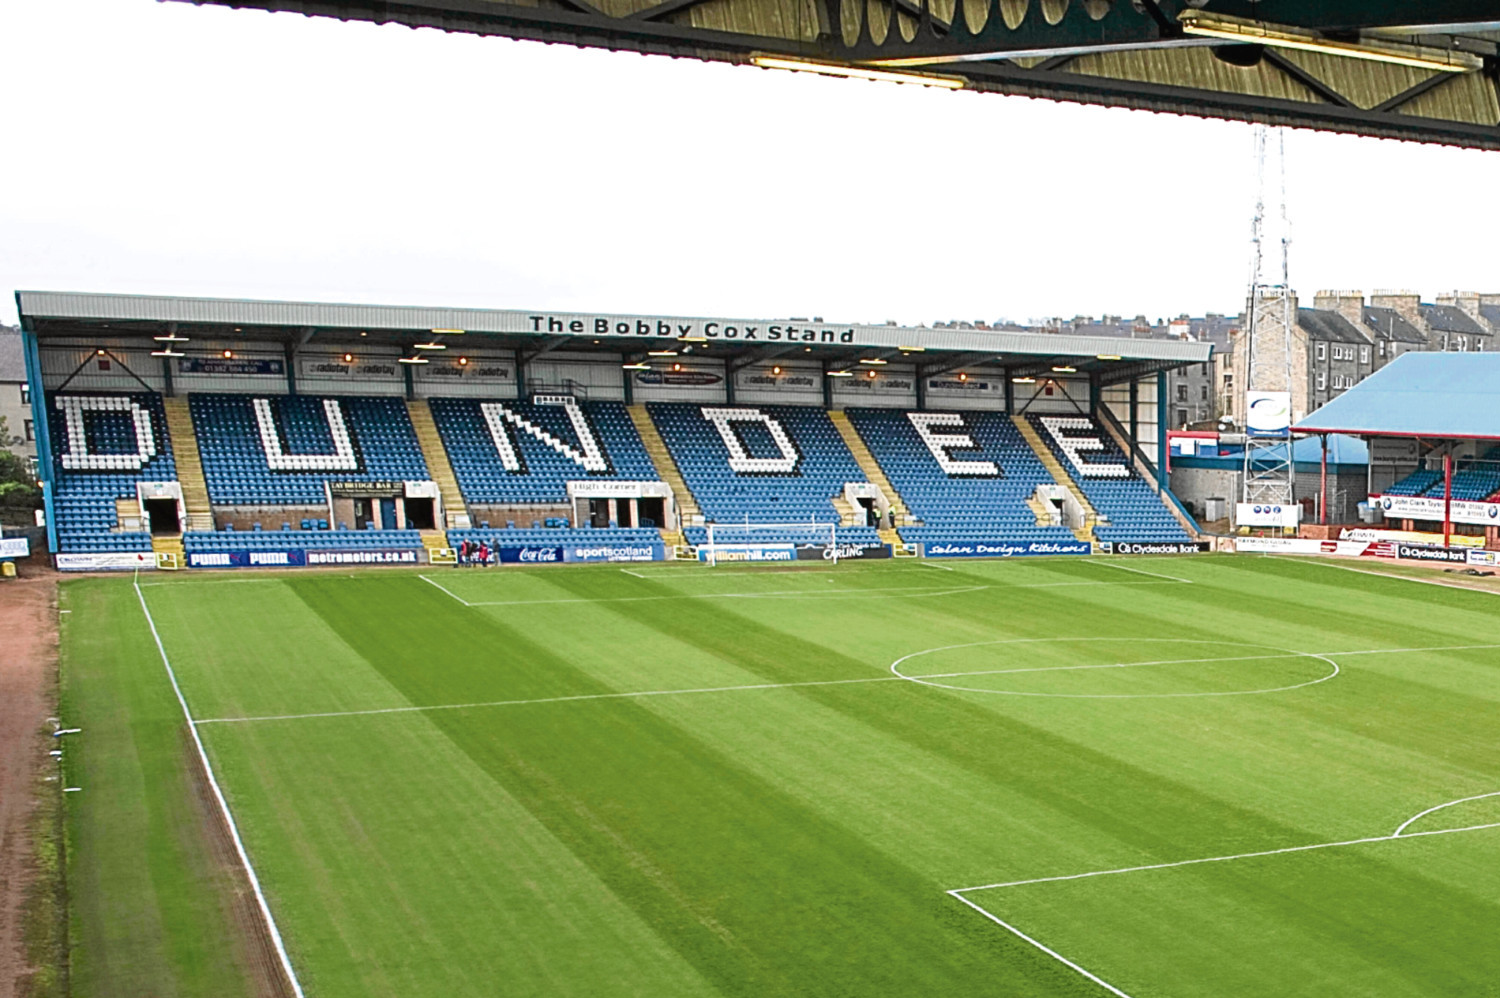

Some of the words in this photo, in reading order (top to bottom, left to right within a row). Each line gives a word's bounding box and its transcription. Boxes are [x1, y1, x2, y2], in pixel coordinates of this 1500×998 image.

[529, 316, 584, 333] The
[594, 319, 692, 338] Bobby
[704, 323, 758, 340] Cox
[768, 324, 855, 343] Stand
[576, 545, 653, 560] sportscotland
[1028, 543, 1088, 553] Kitchens
[1132, 544, 1178, 555] Clydesdale
[1180, 544, 1200, 554] Bank
[1411, 548, 1448, 560] Clydesdale
[190, 553, 232, 566] PUMA
[249, 552, 291, 565] PUMA
